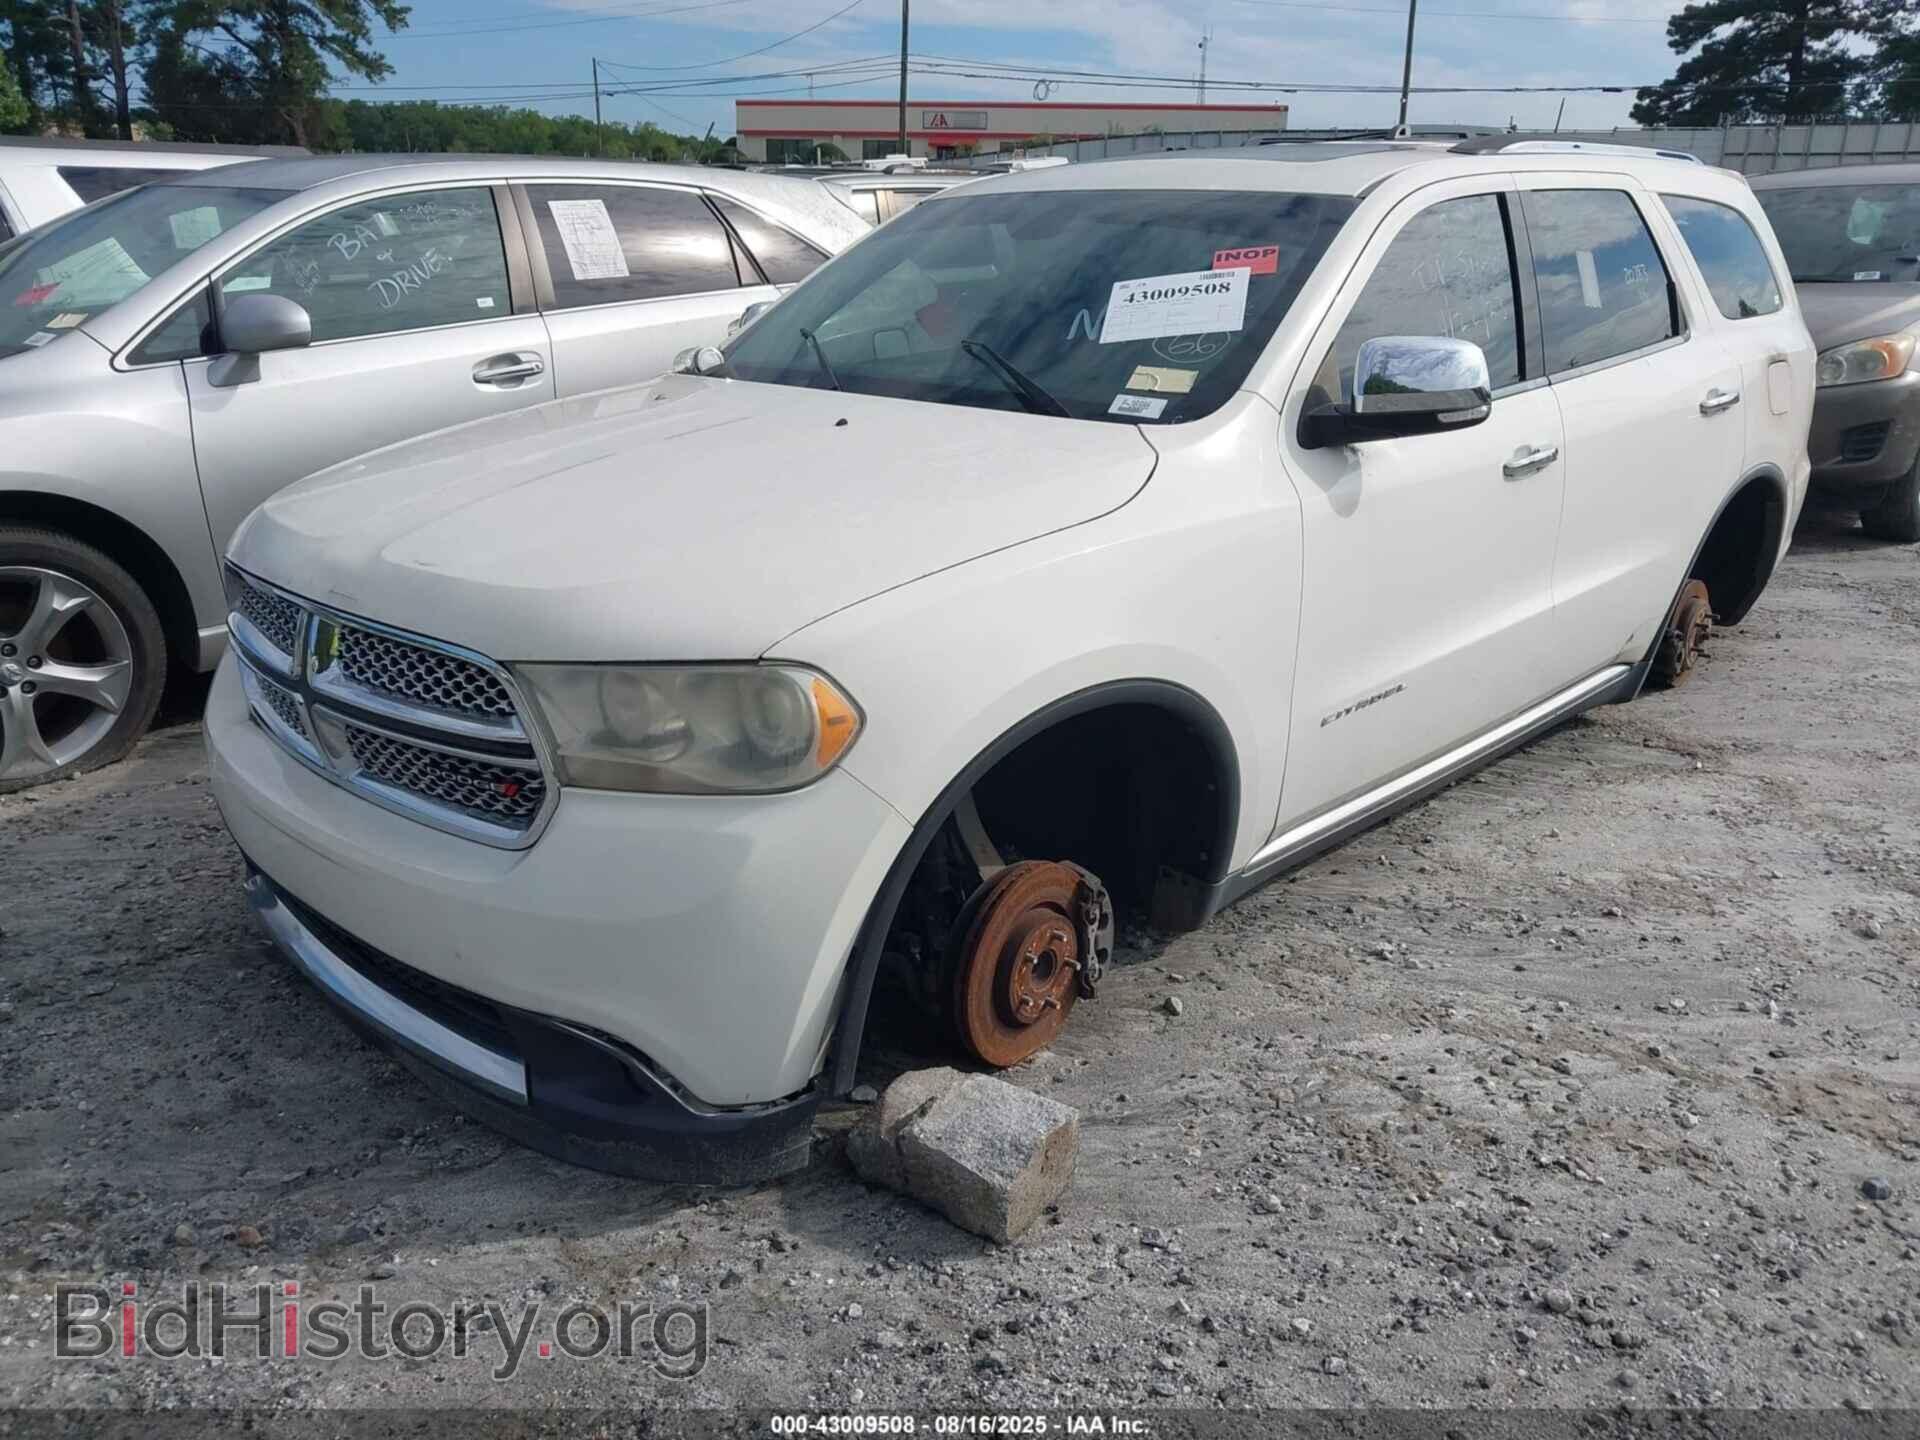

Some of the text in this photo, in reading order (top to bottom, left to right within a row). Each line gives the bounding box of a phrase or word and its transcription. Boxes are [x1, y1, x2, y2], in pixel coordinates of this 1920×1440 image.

[1216, 249, 1277, 262] INOP
[1123, 281, 1231, 304] 43009508
[1320, 683, 1408, 728] CITADEL
